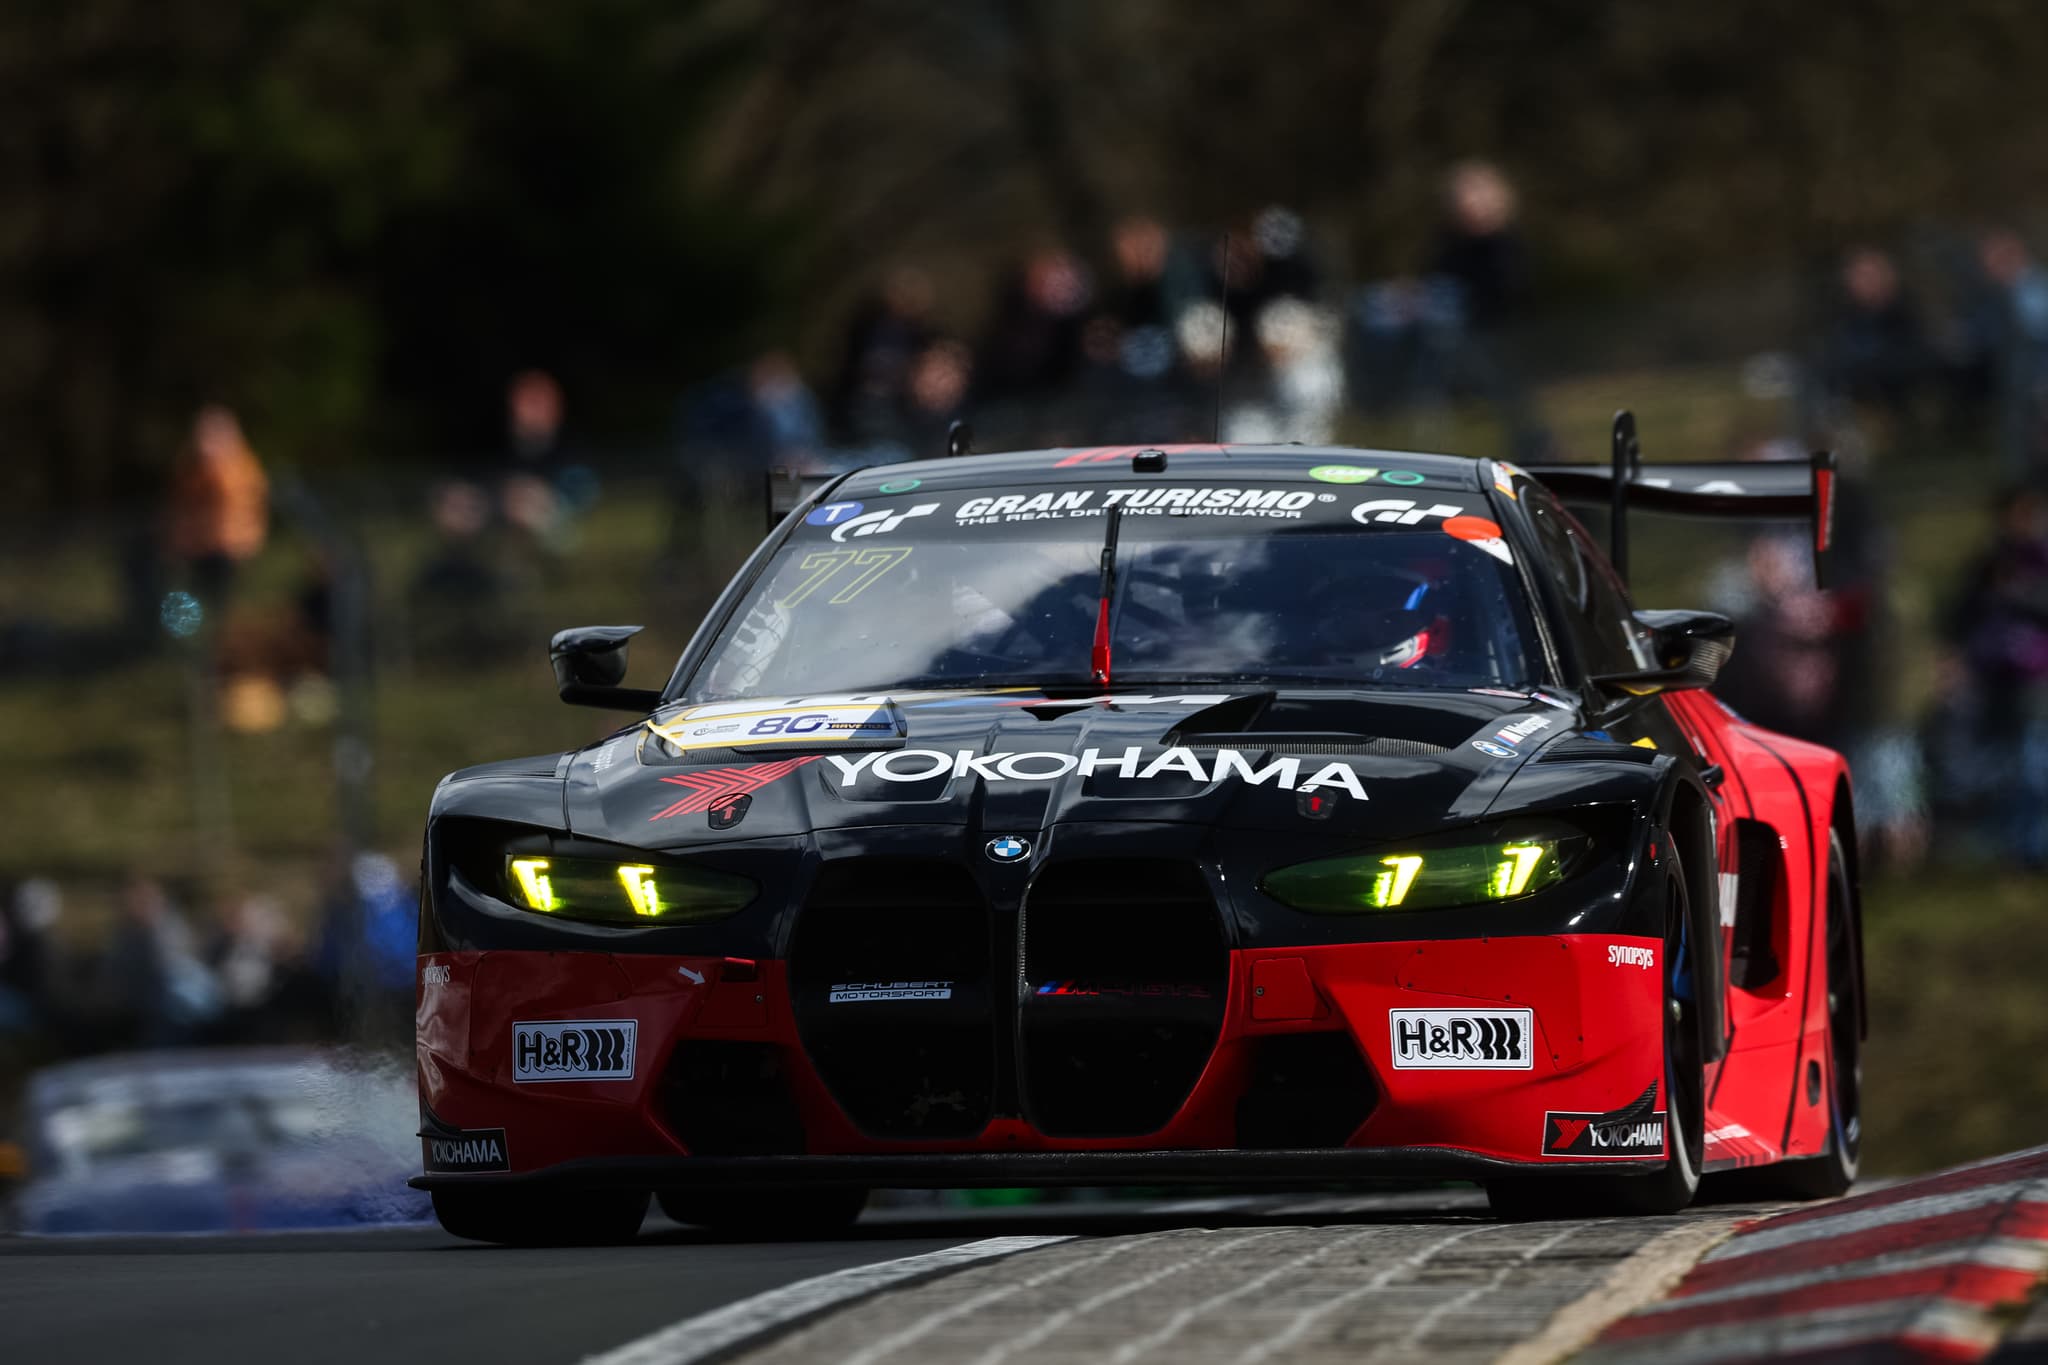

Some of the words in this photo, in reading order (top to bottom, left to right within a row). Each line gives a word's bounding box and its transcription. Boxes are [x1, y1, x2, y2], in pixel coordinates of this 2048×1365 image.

[955, 490, 1095, 518] GRAN
[955, 515, 1000, 526] THE
[1005, 511, 1064, 522] REAL
[1070, 507, 1163, 517] DRING
[1169, 508, 1302, 518] SIMULATOR
[781, 547, 913, 608] 77
[748, 714, 829, 735] 80
[825, 746, 1369, 800] YOKOHAMA
[1608, 945, 1654, 970] SYNOPSYS
[832, 981, 954, 991] SCHUBERT
[835, 990, 946, 1000] MOTORSPORT
[1398, 1019, 1477, 1057] H&R
[518, 1031, 585, 1070] H&R
[1588, 1123, 1662, 1146] YOKOHAMA
[431, 1139, 503, 1163] YOKOHAMA
